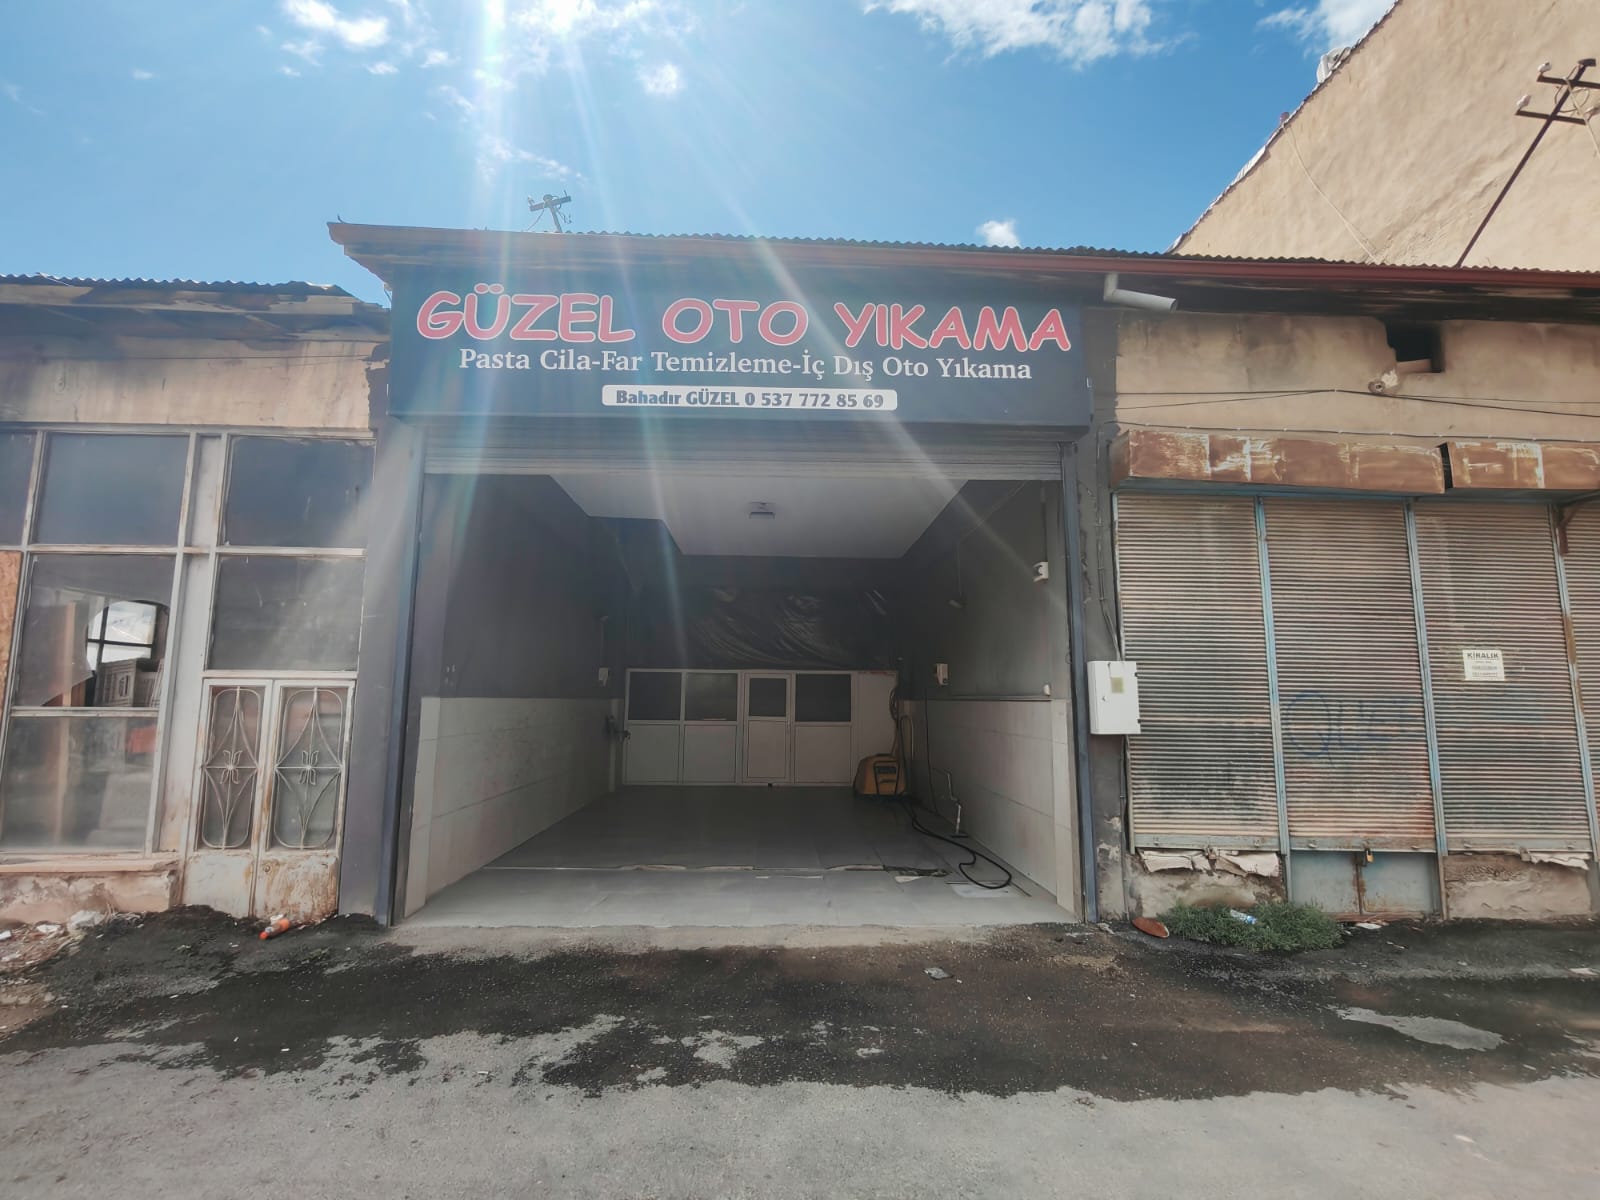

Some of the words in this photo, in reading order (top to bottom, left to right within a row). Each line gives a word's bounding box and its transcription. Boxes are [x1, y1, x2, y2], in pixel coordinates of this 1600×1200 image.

[416, 283, 636, 343] GÜZEL
[662, 297, 809, 346] OTO
[833, 301, 1072, 352] YIKAMA
[459, 348, 531, 370] Pasta
[540, 349, 642, 373] Cila-Far
[651, 349, 825, 380] Temizleme-İç
[833, 354, 874, 381] Dış
[882, 356, 929, 377] Oto
[936, 357, 1032, 379] Yıkama
[616, 389, 681, 406] Bahadır
[686, 388, 740, 407] GÜZEL
[744, 392, 755, 406] 0
[761, 392, 793, 408] 537
[799, 393, 831, 408] 772
[836, 393, 858, 408] 85
[863, 394, 884, 409] 69
